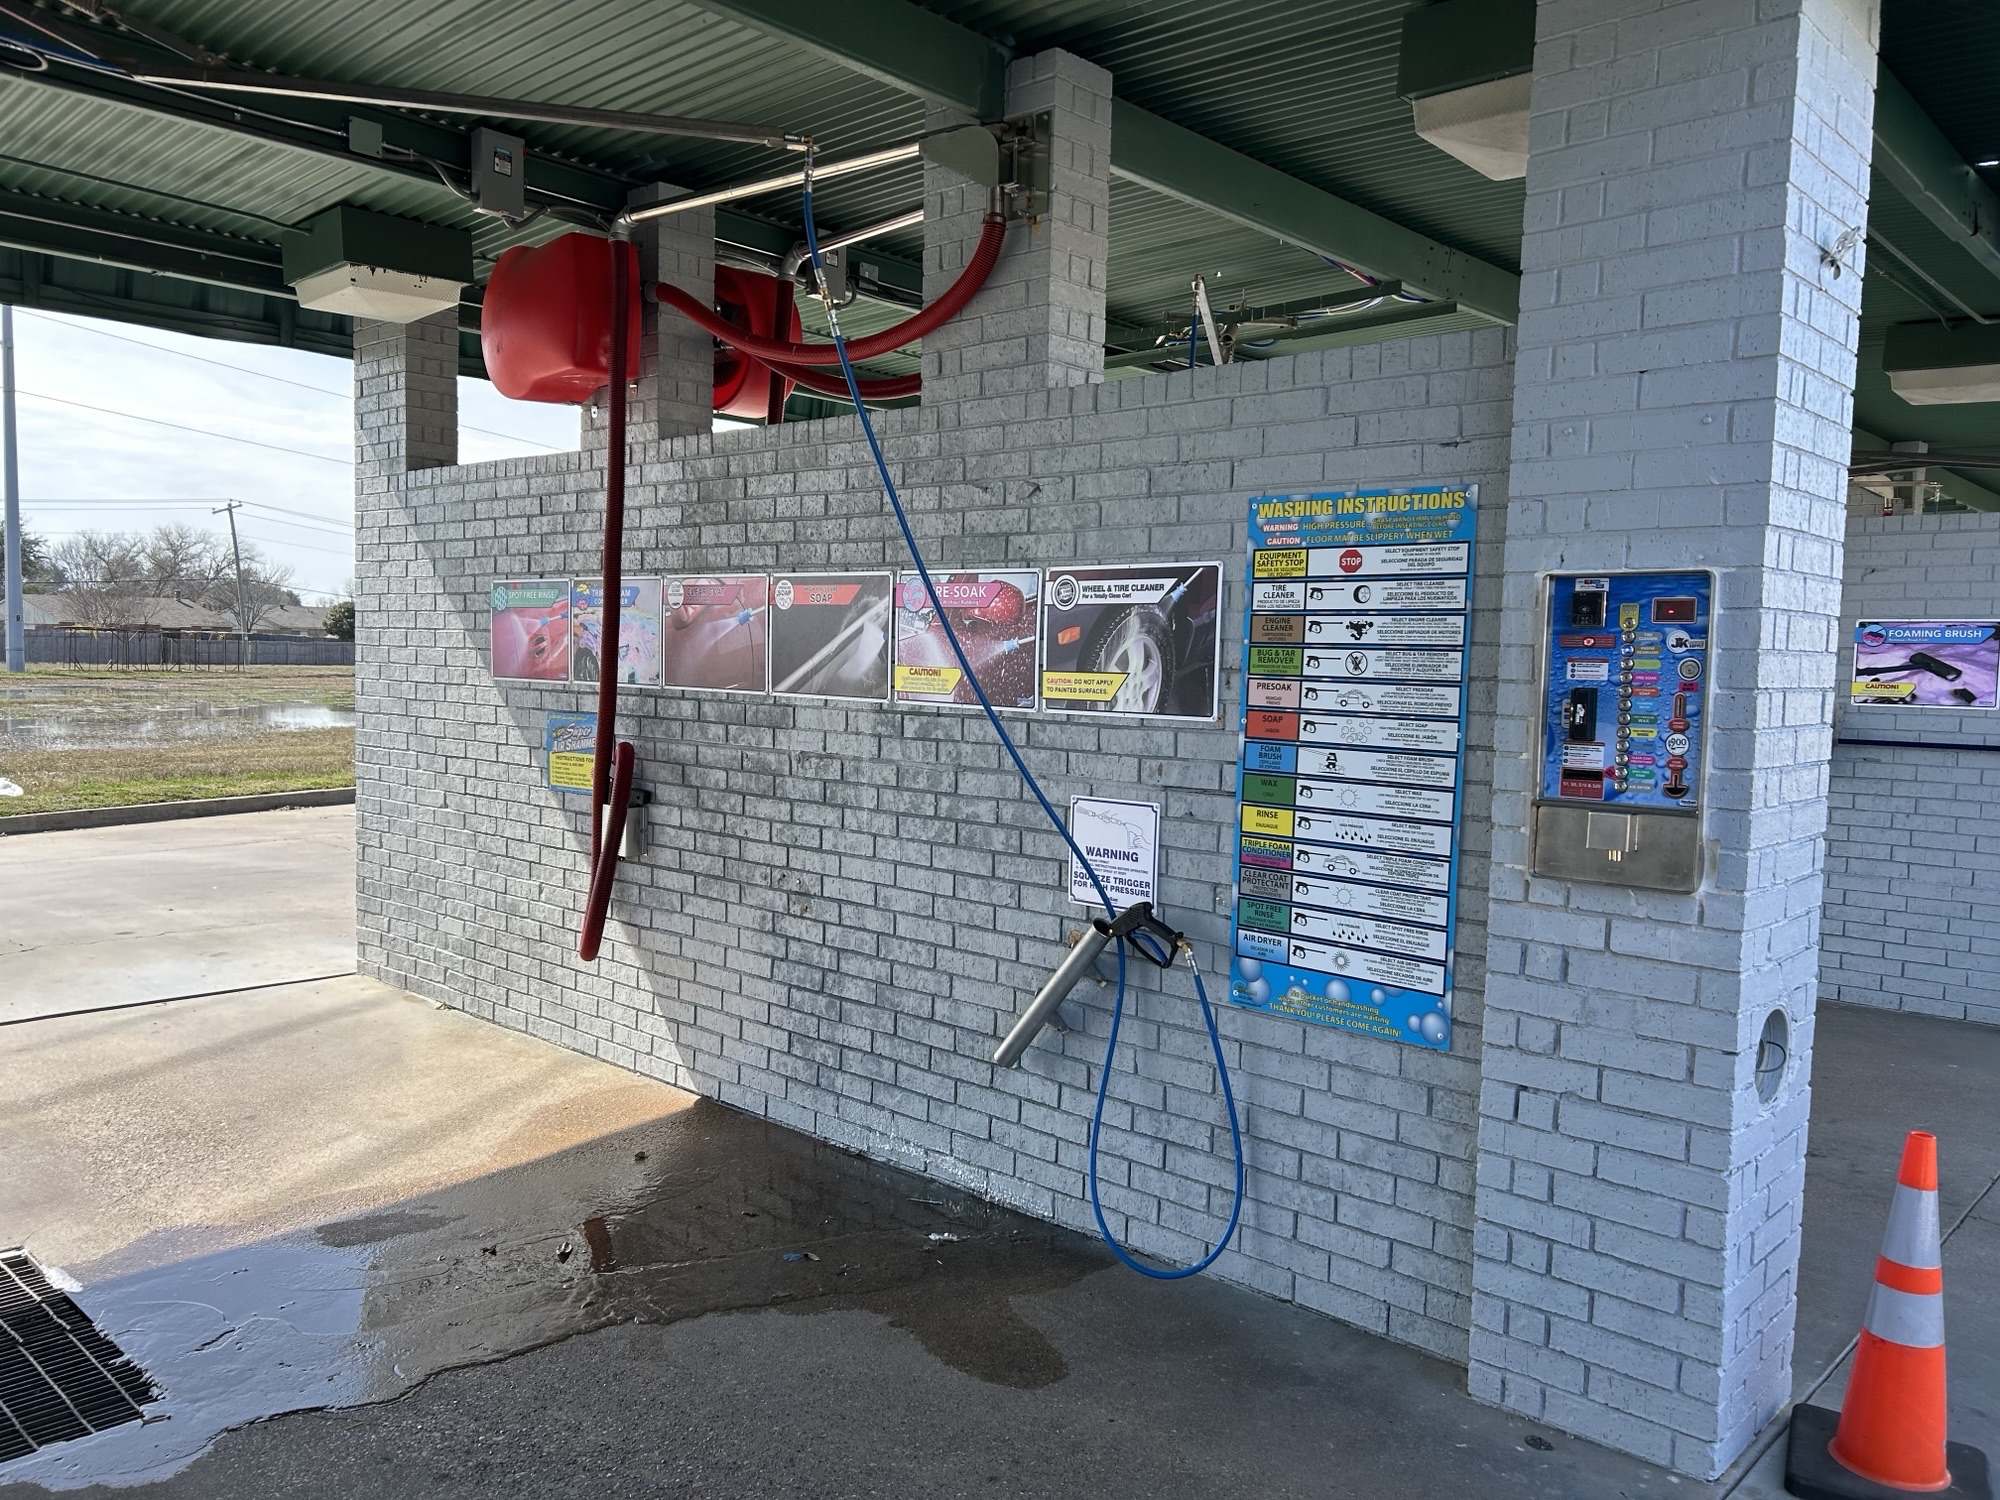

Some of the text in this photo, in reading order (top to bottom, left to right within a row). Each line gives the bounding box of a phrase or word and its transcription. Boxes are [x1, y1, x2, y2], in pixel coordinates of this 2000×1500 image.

[1259, 492, 1464, 519] WASHING INSTRUCTIONS
[1263, 524, 1298, 532] WARNING
[1303, 522, 1323, 530] HIGH
[1325, 520, 1366, 530] PRESSURE
[1267, 537, 1300, 545] CAUTION
[1366, 533, 1405, 541] SLIPPERY
[1260, 552, 1302, 560] EQUIPMENT
[1341, 557, 1361, 566] STOP
[1257, 559, 1283, 567] SAFETY
[936, 586, 986, 597] RE-SOAK
[1113, 584, 1129, 592] TIRE
[810, 594, 832, 602] SOAP
[1889, 630, 1941, 638] FOAMING
[909, 668, 941, 676] CAUTION!
[1257, 682, 1292, 691] PRESOAK
[554, 740, 565, 752] AIR
[1259, 752, 1282, 760] BRUSH
[1261, 779, 1277, 787] WAX
[1256, 810, 1278, 819] RINSE
[1244, 839, 1290, 851] TRIPLE FOAM
[1086, 846, 1138, 862] WARNING
[1242, 846, 1291, 858] CONDITIONER
[1244, 870, 1288, 882] CLEAR COAT
[1113, 877, 1150, 889] TRIGGER
[1242, 876, 1289, 890] PROTECTANT
[1110, 885, 1150, 897] PRESSURE
[1247, 902, 1282, 913] SPOT FREE
[1254, 910, 1274, 919] RINSE
[1243, 934, 1282, 947] AIR DRYER
[1315, 1004, 1349, 1015] customers
[1332, 998, 1379, 1015] handwashing
[1270, 1002, 1401, 1037] THANK YOU! PLEASE COME AGAIN!
